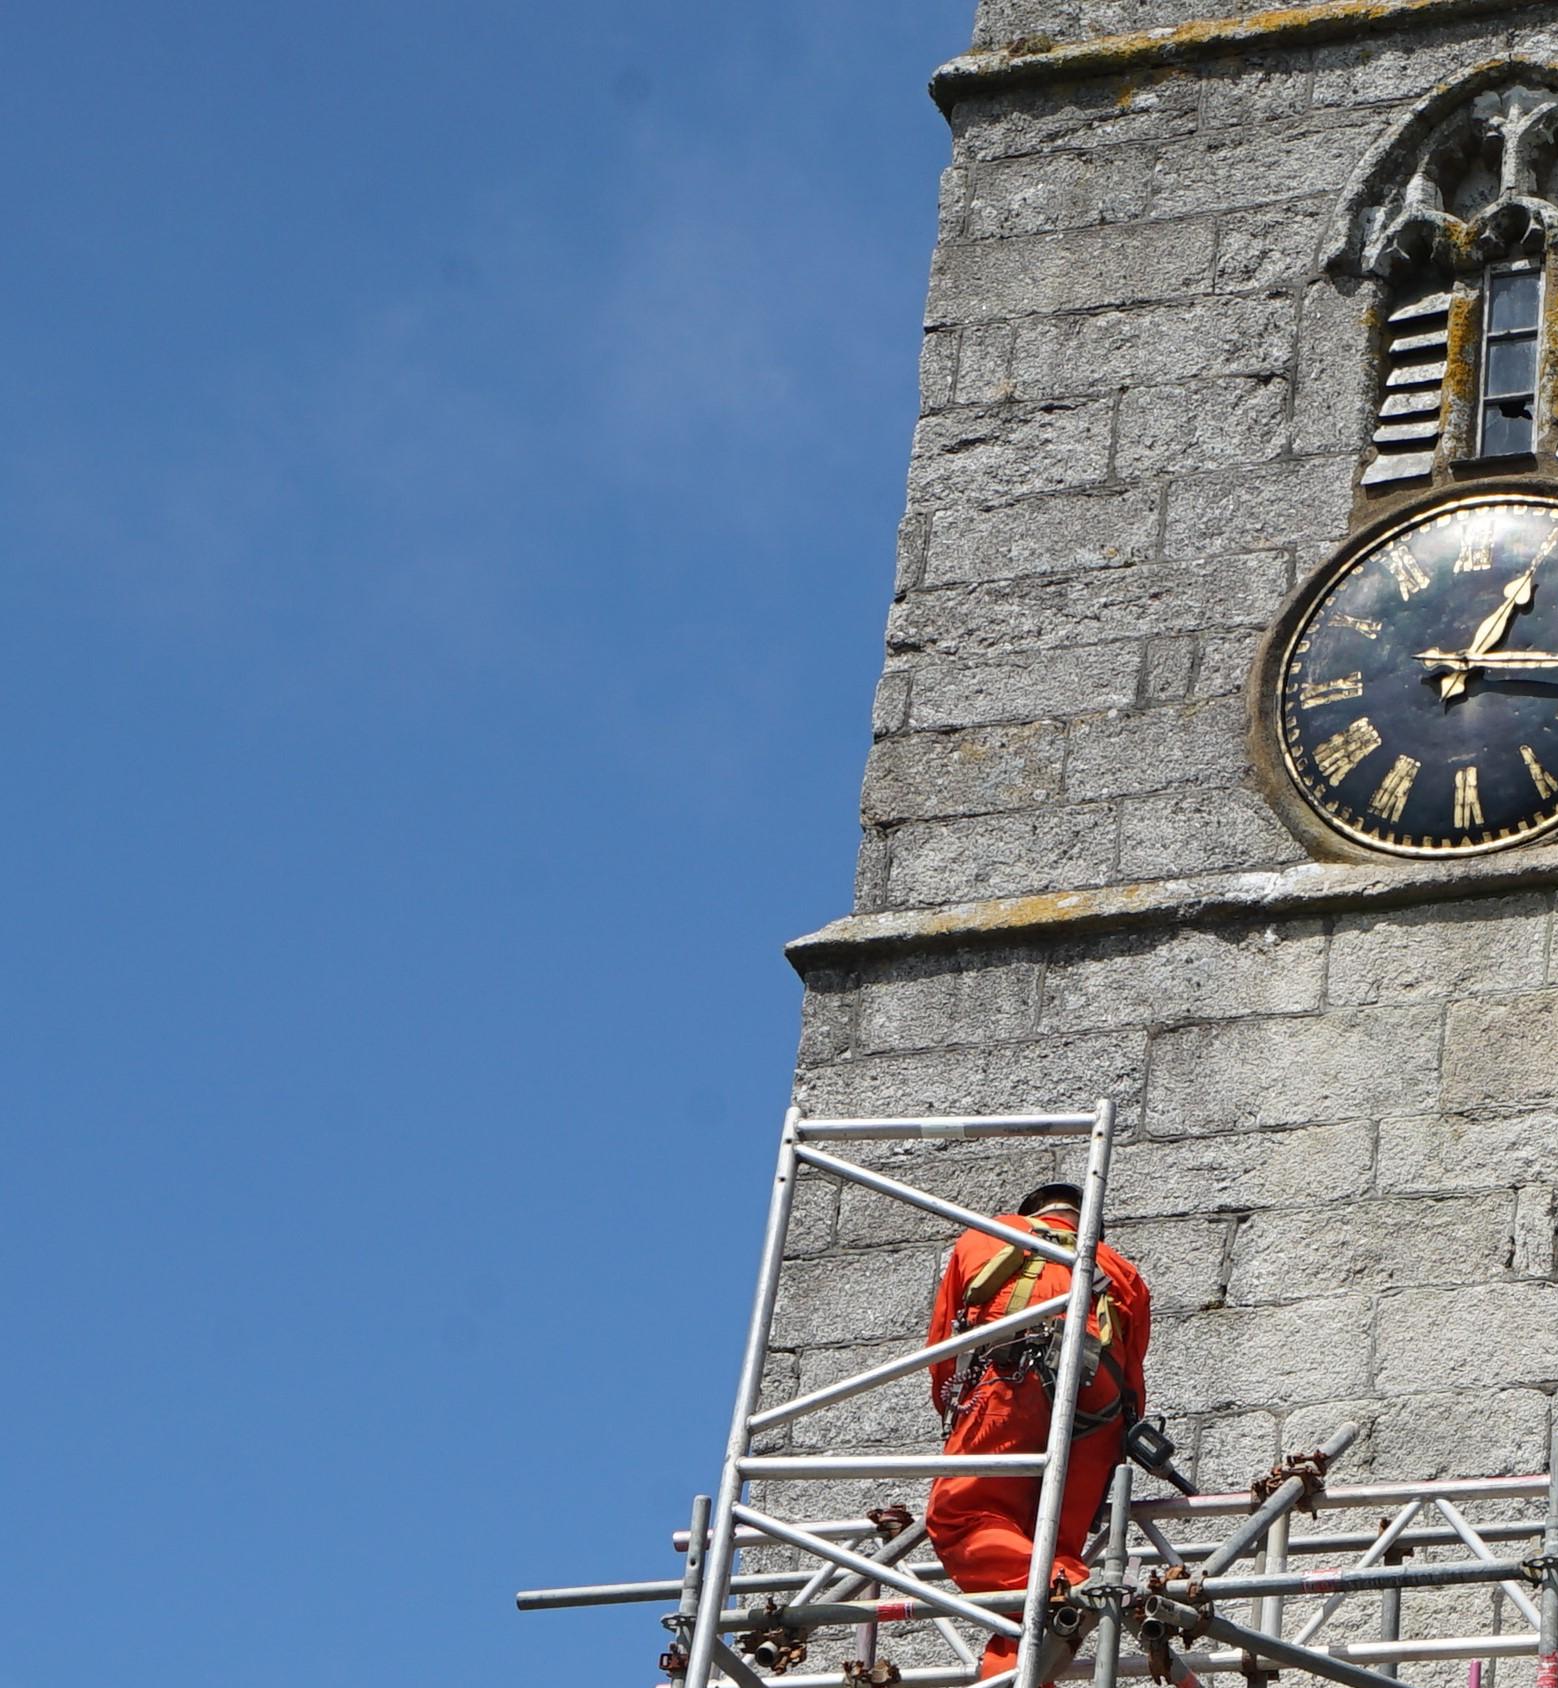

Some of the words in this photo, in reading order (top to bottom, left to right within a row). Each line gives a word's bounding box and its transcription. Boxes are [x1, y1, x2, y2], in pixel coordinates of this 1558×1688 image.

[1380, 544, 1431, 602] XI
[1453, 518, 1496, 573] XII
[1327, 612, 1383, 640] X
[1300, 671, 1363, 710] IX
[1312, 716, 1382, 787] VIII
[1367, 753, 1422, 824] VII
[1454, 765, 1485, 829] VI
